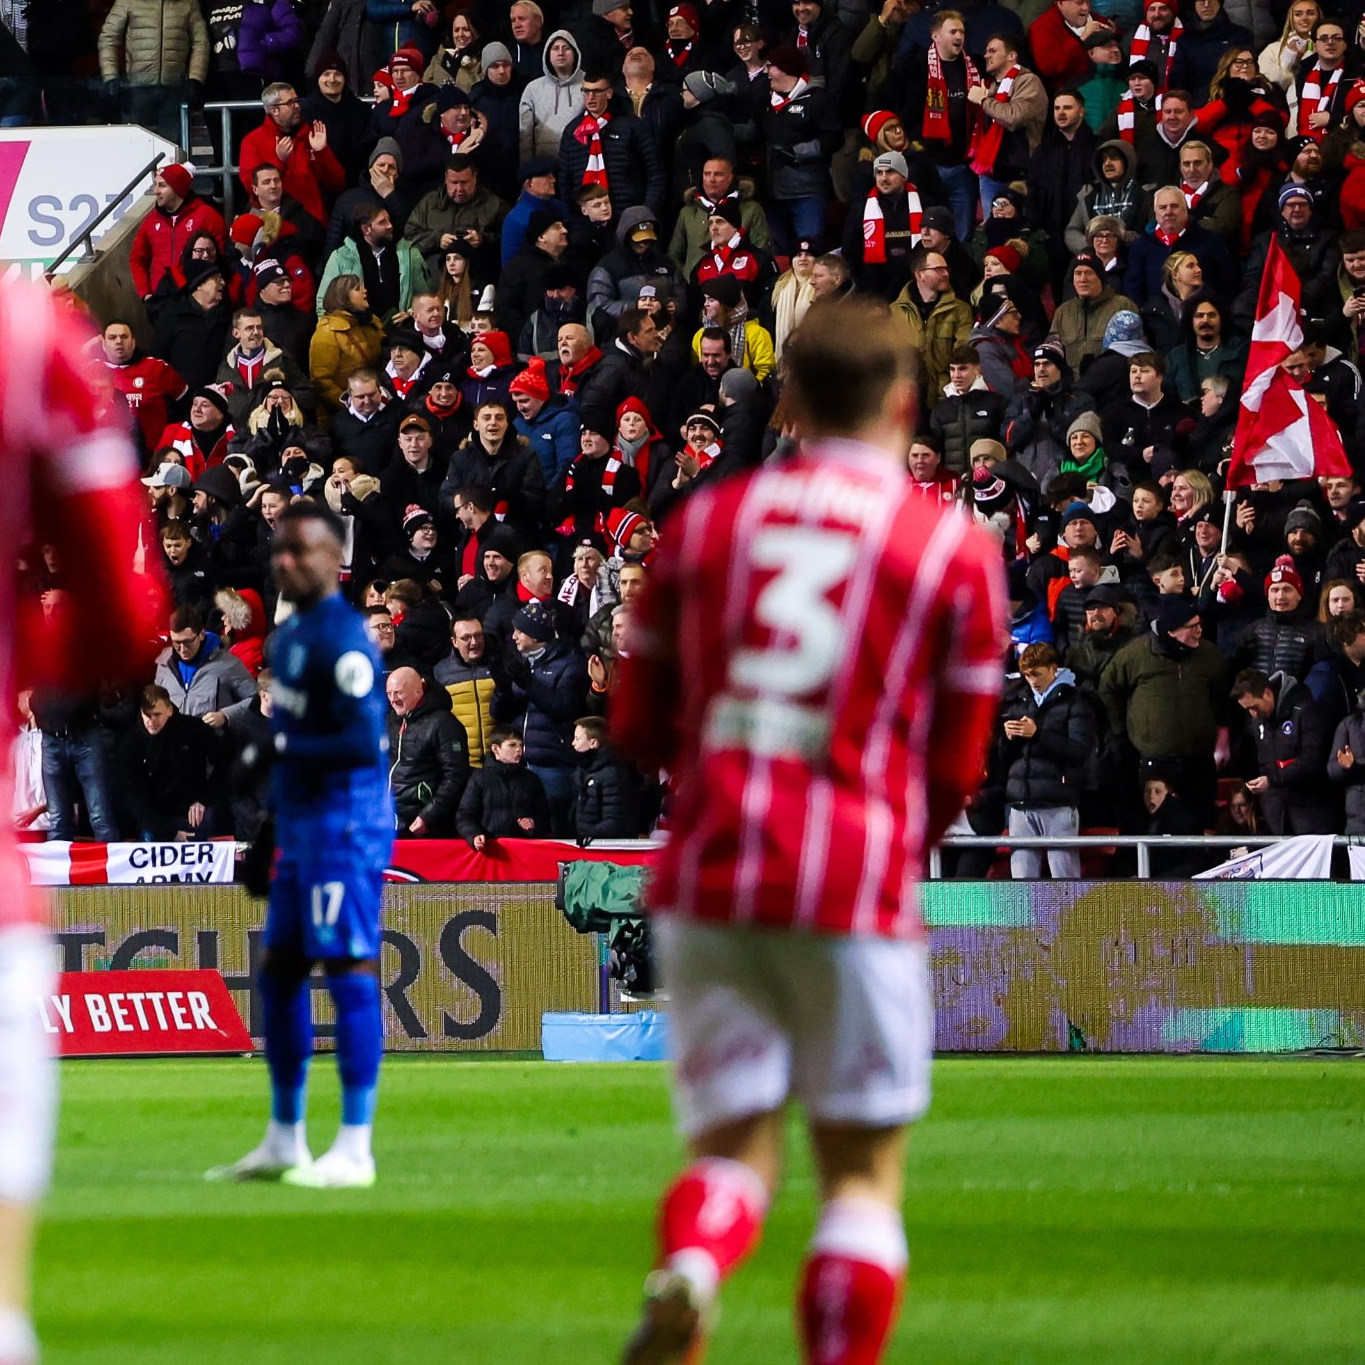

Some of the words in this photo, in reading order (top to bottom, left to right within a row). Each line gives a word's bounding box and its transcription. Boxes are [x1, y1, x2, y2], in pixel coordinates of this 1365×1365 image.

[727, 523, 861, 692] 3
[129, 842, 214, 869] CIDER
[310, 880, 346, 928] 17
[84, 990, 219, 1033] BETTER
